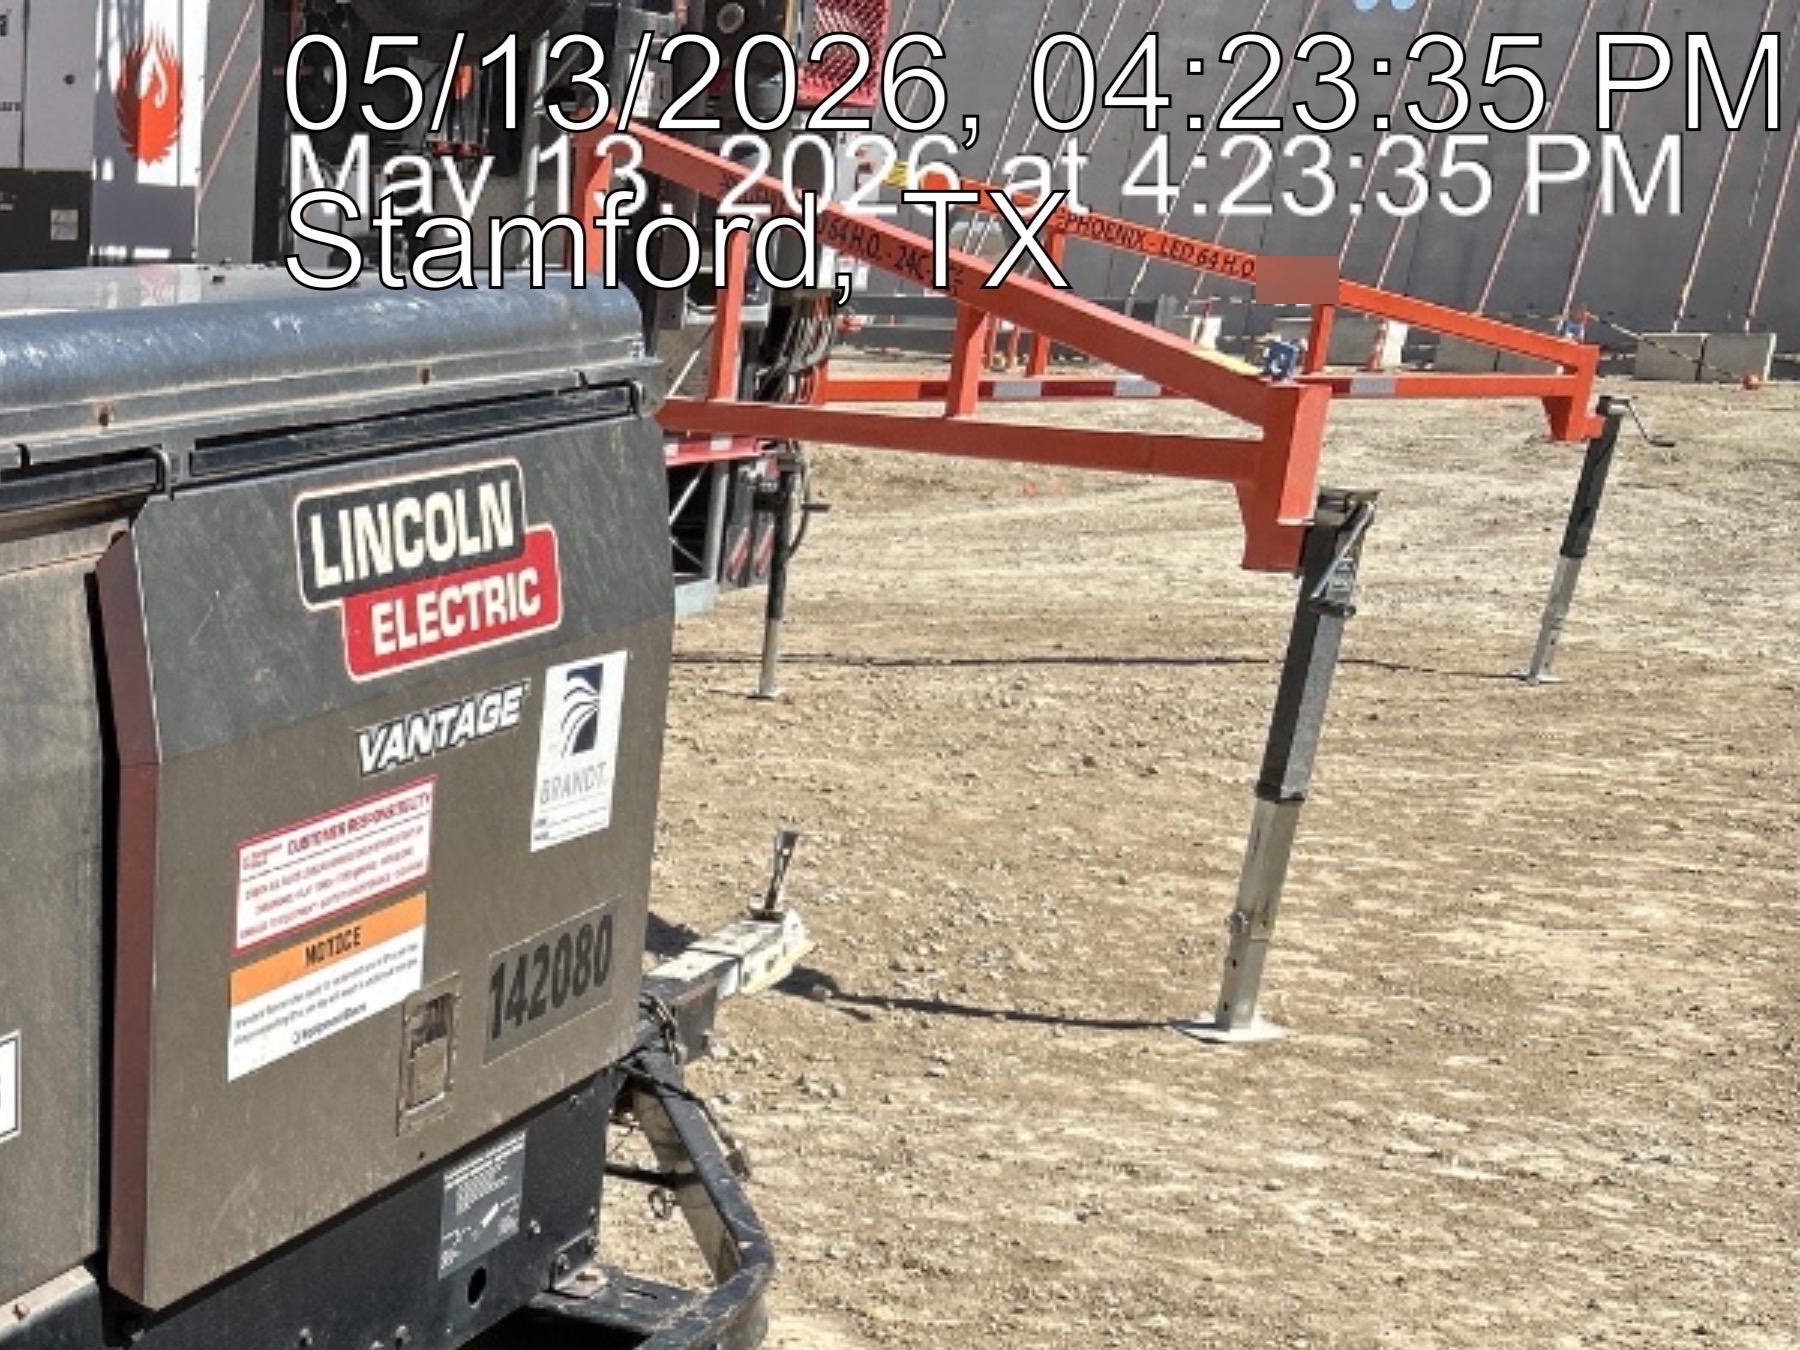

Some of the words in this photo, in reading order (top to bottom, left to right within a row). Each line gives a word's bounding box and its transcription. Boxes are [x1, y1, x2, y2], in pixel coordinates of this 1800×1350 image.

[1065, 214, 1147, 250] PHOENIX
[1161, 233, 1195, 259] LED
[311, 480, 515, 588] LINCOLN
[372, 566, 541, 657] ELECTRIC
[356, 681, 527, 777] VANTAGE
[304, 926, 362, 967] NOTICE
[489, 914, 613, 1040] 142080
